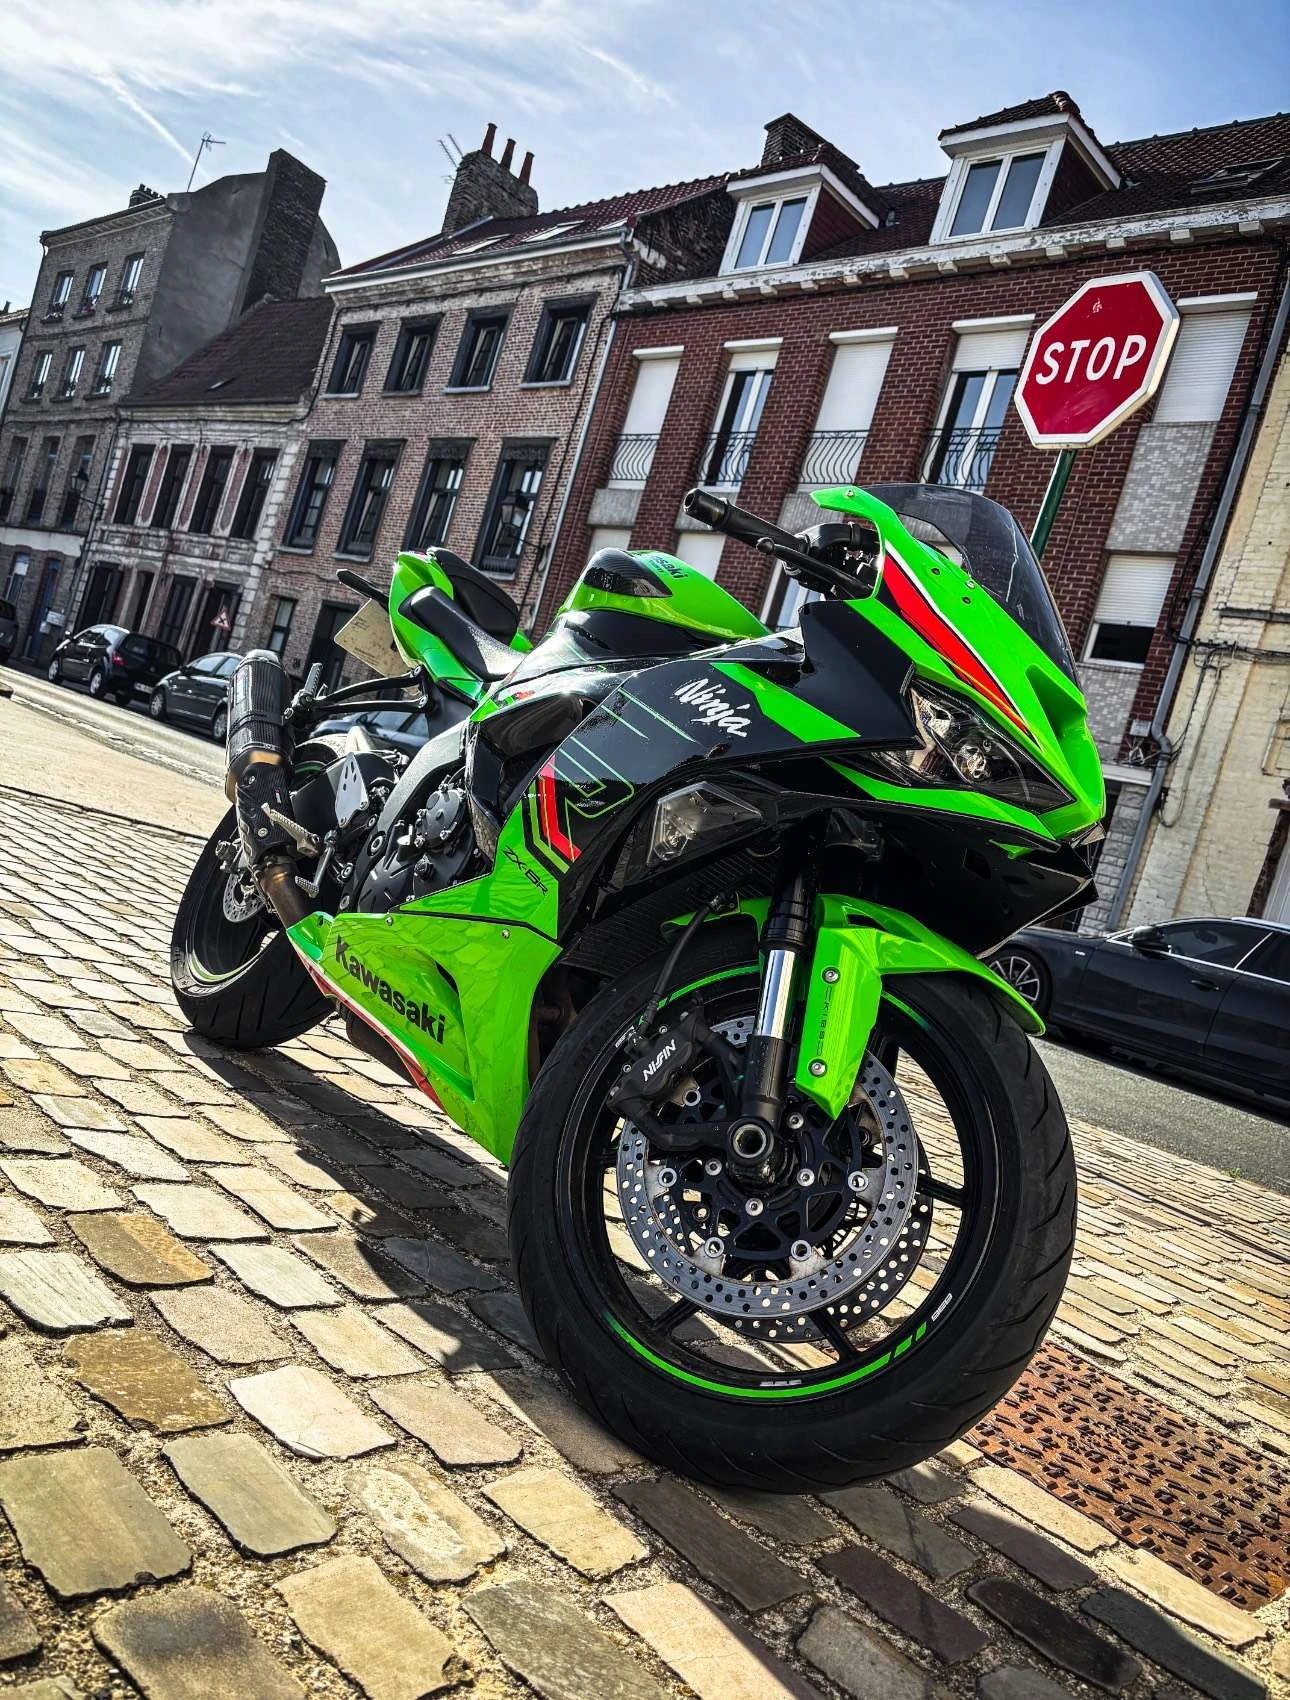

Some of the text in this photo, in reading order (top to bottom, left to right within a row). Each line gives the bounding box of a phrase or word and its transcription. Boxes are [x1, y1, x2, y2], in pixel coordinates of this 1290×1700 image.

[1035, 334, 1147, 385] STOP
[673, 677, 751, 738] Ninja
[335, 934, 446, 1045] Kawasaki
[642, 1038, 677, 1082] NISSIN
